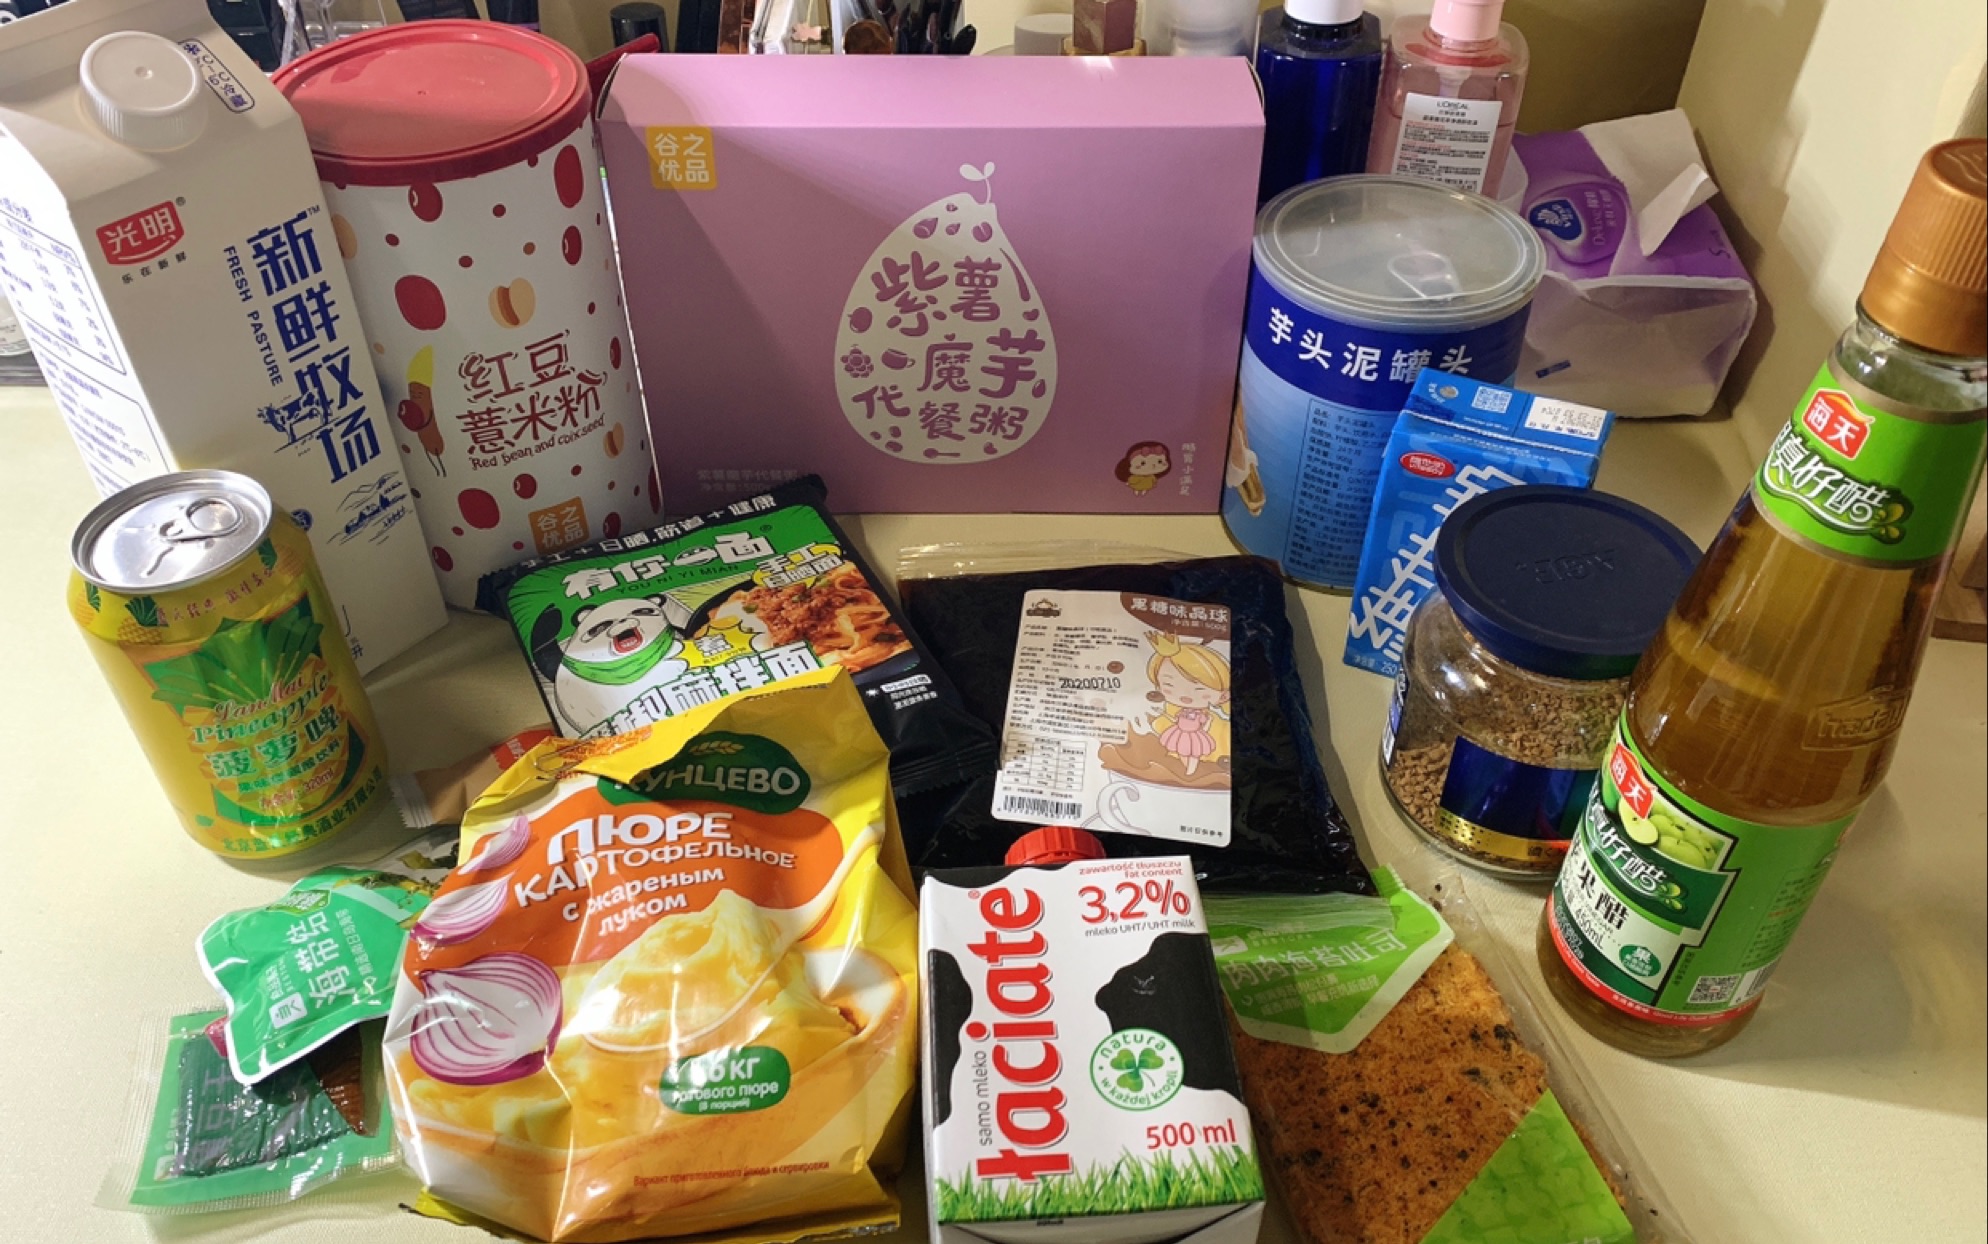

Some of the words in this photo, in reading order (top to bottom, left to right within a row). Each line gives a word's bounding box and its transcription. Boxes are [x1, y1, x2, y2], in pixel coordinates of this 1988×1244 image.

[654, 133, 707, 158] 谷之
[658, 159, 710, 184] 优品
[104, 207, 176, 255] 光明
[121, 251, 187, 286] 乐在新鲜
[223, 245, 253, 303] FRESH
[246, 310, 284, 388] PASTURE
[871, 250, 1002, 337] 紫薯
[246, 211, 382, 483] 新鲜牧场
[458, 329, 575, 404] 红豆
[917, 329, 1047, 399] 魔芋
[1268, 307, 1474, 384] 芋头泥罐头
[456, 369, 608, 456] 薏米粉
[853, 384, 1030, 441] 代餐粥
[1805, 396, 1861, 453] 海天
[470, 450, 498, 471] Red
[501, 445, 534, 467] bean
[534, 434, 556, 455] and
[536, 504, 580, 529] 谷之
[541, 522, 585, 550] 优品
[616, 579, 653, 596] YOU
[678, 570, 697, 583] YI
[699, 564, 740, 578] MIAN
[1130, 596, 1229, 624] 黑糖味晶球
[1059, 676, 1121, 690] 20200710
[192, 671, 328, 745] Pineapple
[204, 703, 341, 780] 菠萝啤
[547, 811, 734, 866] ПЮРЕ
[513, 840, 798, 908] КАРТОФЕЛЬНОЕ
[586, 867, 726, 916] жареным
[1124, 869, 1140, 879] fat
[1142, 867, 1184, 878] content
[597, 892, 689, 938] луком
[1078, 878, 1192, 925] 3,2%
[1085, 925, 1118, 938] mleko
[1172, 918, 1197, 929] milk
[965, 886, 1075, 1185] łaciate
[1101, 1033, 1167, 1059] natura
[738, 1080, 780, 1099] пюре
[976, 1050, 989, 1098] mleko
[979, 1098, 993, 1147] samo
[1146, 1121, 1196, 1151] 500
[1202, 1117, 1237, 1144] ml
[633, 1173, 669, 1188] Вариант
